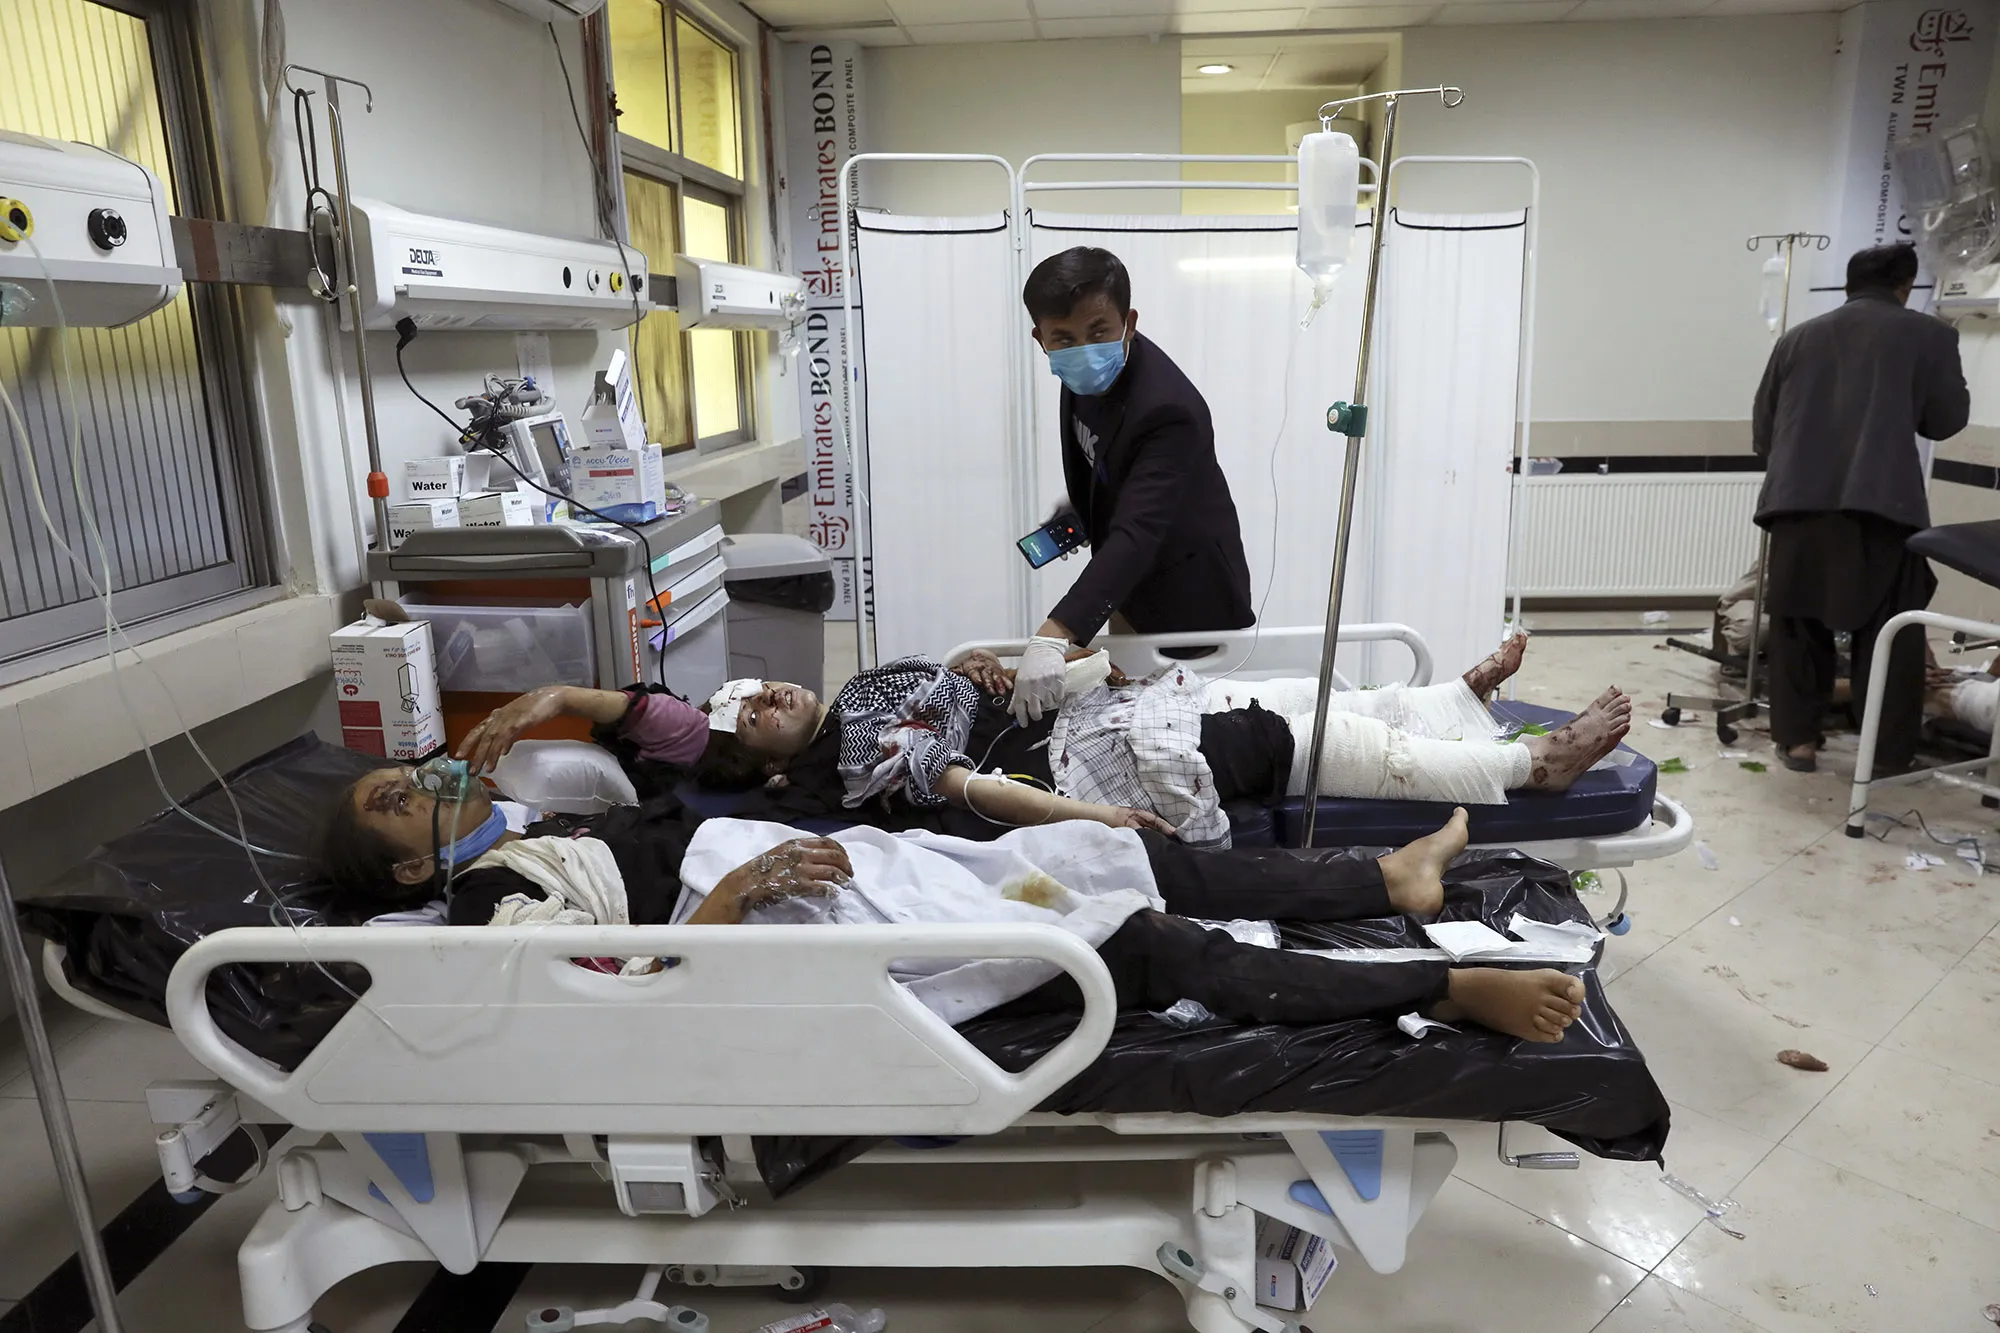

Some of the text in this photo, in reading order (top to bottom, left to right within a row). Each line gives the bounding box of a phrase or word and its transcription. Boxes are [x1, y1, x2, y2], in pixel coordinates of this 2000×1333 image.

[811, 45, 836, 134] BOND
[844, 57, 855, 89] PANEL
[1891, 63, 1908, 104] TWN
[1912, 63, 1947, 133] Emir
[846, 93, 857, 150] COMPOSITE
[816, 139, 840, 252] Emirates
[1876, 174, 1891, 232] COMPOSITE
[806, 313, 832, 396] BOND
[811, 401, 836, 507] Emirates
[412, 481, 447, 491] Water
[842, 577, 852, 604] PANEL
[393, 739, 436, 759] Safety Box
[398, 741, 418, 749] Waste
